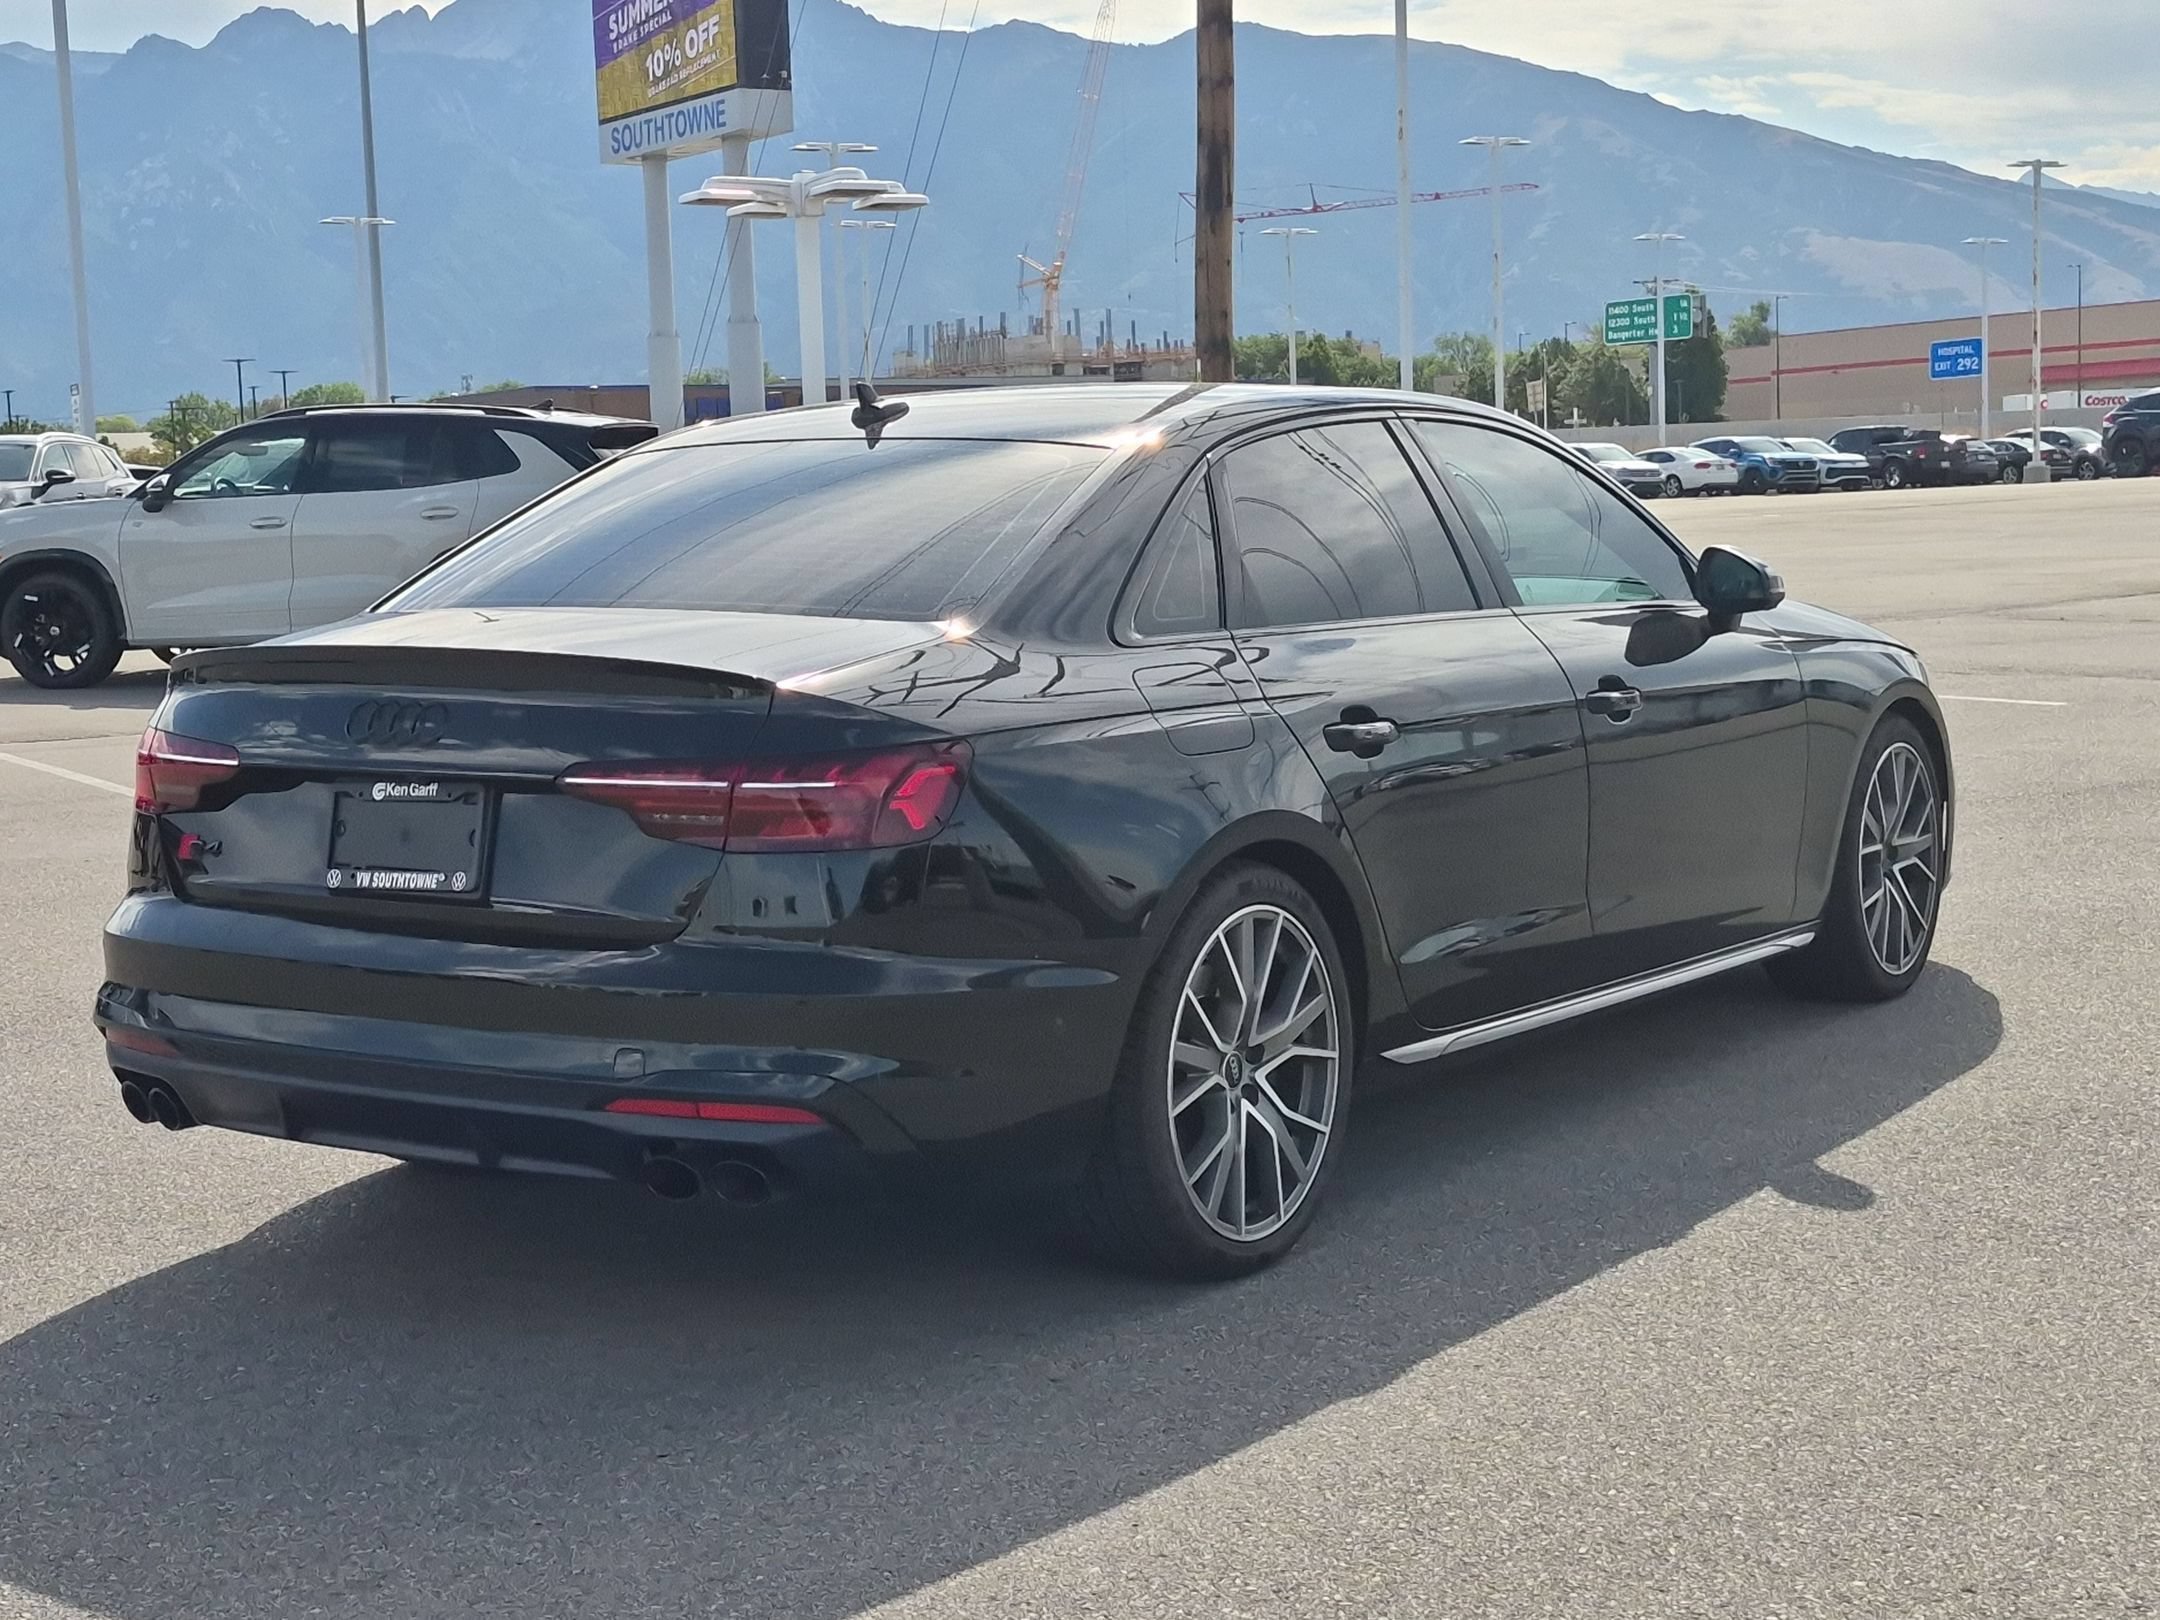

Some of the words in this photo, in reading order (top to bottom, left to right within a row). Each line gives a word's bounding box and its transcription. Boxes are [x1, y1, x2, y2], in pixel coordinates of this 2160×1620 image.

[640, 9, 672, 37] SPECIAL
[646, 37, 682, 82] 10%
[685, 13, 720, 58] OFF
[611, 99, 727, 154] SOUTHTOWNE
[1632, 303, 1655, 313] South
[1608, 317, 1630, 328] 12300
[1633, 315, 1656, 326] South
[1608, 329, 1646, 340] Bangerter
[1937, 345, 1975, 356] HOSPITAL
[1934, 361, 1951, 371] EXIT
[1957, 356, 1979, 371] 292
[2084, 394, 2128, 407] COSTCO
[386, 782, 408, 797] Ken
[409, 782, 439, 797] Garff
[356, 871, 371, 888] VW
[372, 871, 438, 889] SOUTHTOWNE
